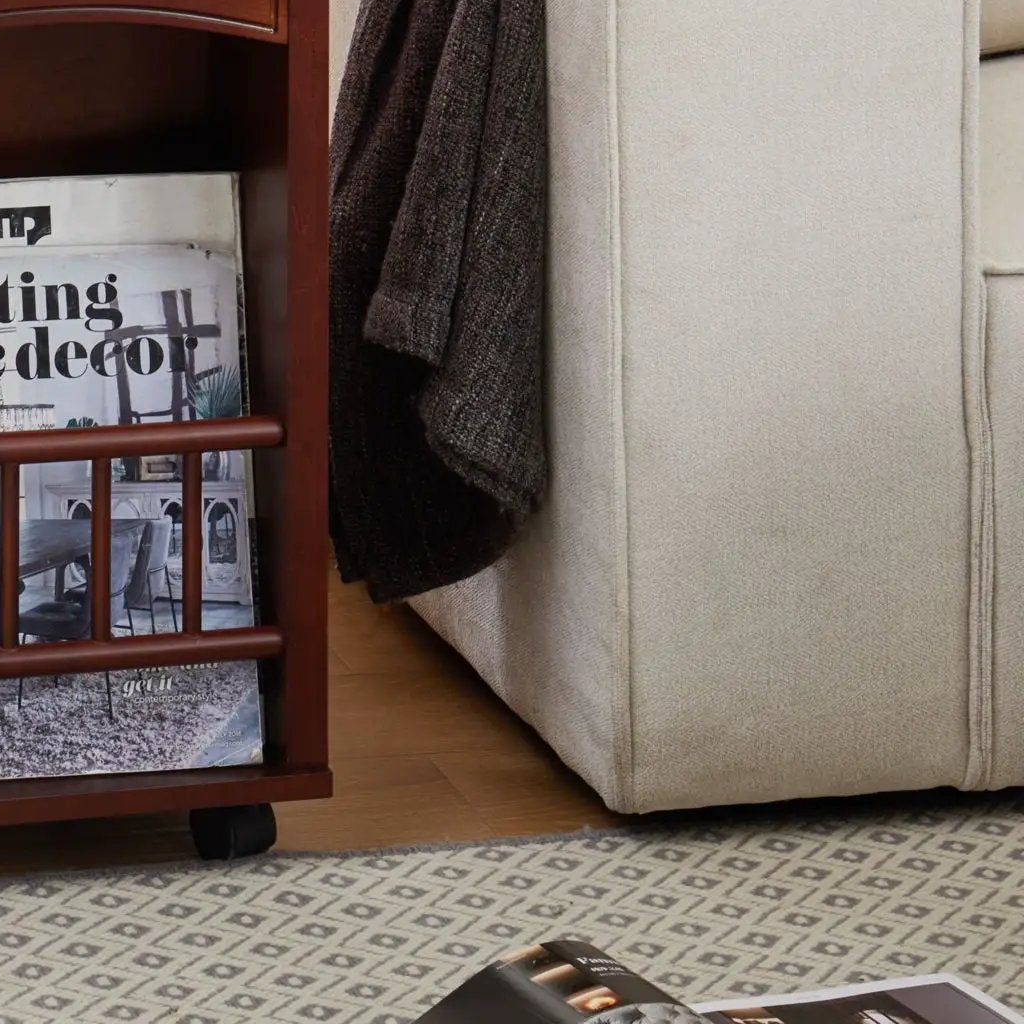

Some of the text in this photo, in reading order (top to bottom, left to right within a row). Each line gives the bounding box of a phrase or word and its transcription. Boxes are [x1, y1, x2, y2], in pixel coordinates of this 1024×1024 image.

[122, 674, 174, 698] get it
[134, 693, 196, 704] contemporary
